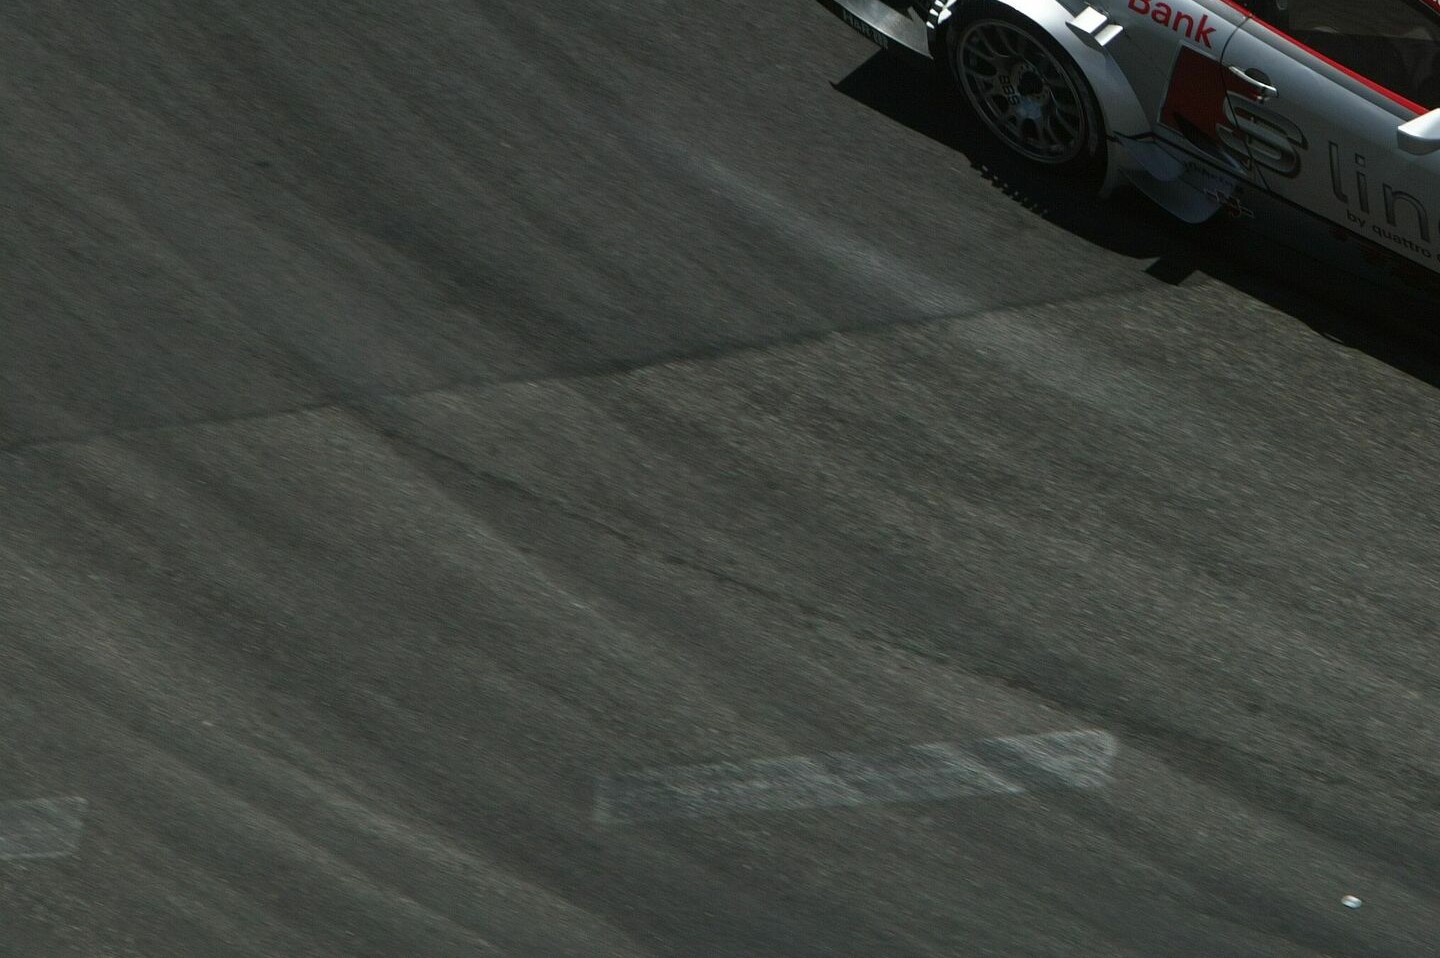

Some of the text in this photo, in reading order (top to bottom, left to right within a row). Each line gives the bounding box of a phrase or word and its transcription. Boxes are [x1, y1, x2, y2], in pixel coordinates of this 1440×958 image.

[999, 75, 1020, 106] BBS
[1346, 208, 1367, 229] by
[1372, 223, 1432, 259] quattro
